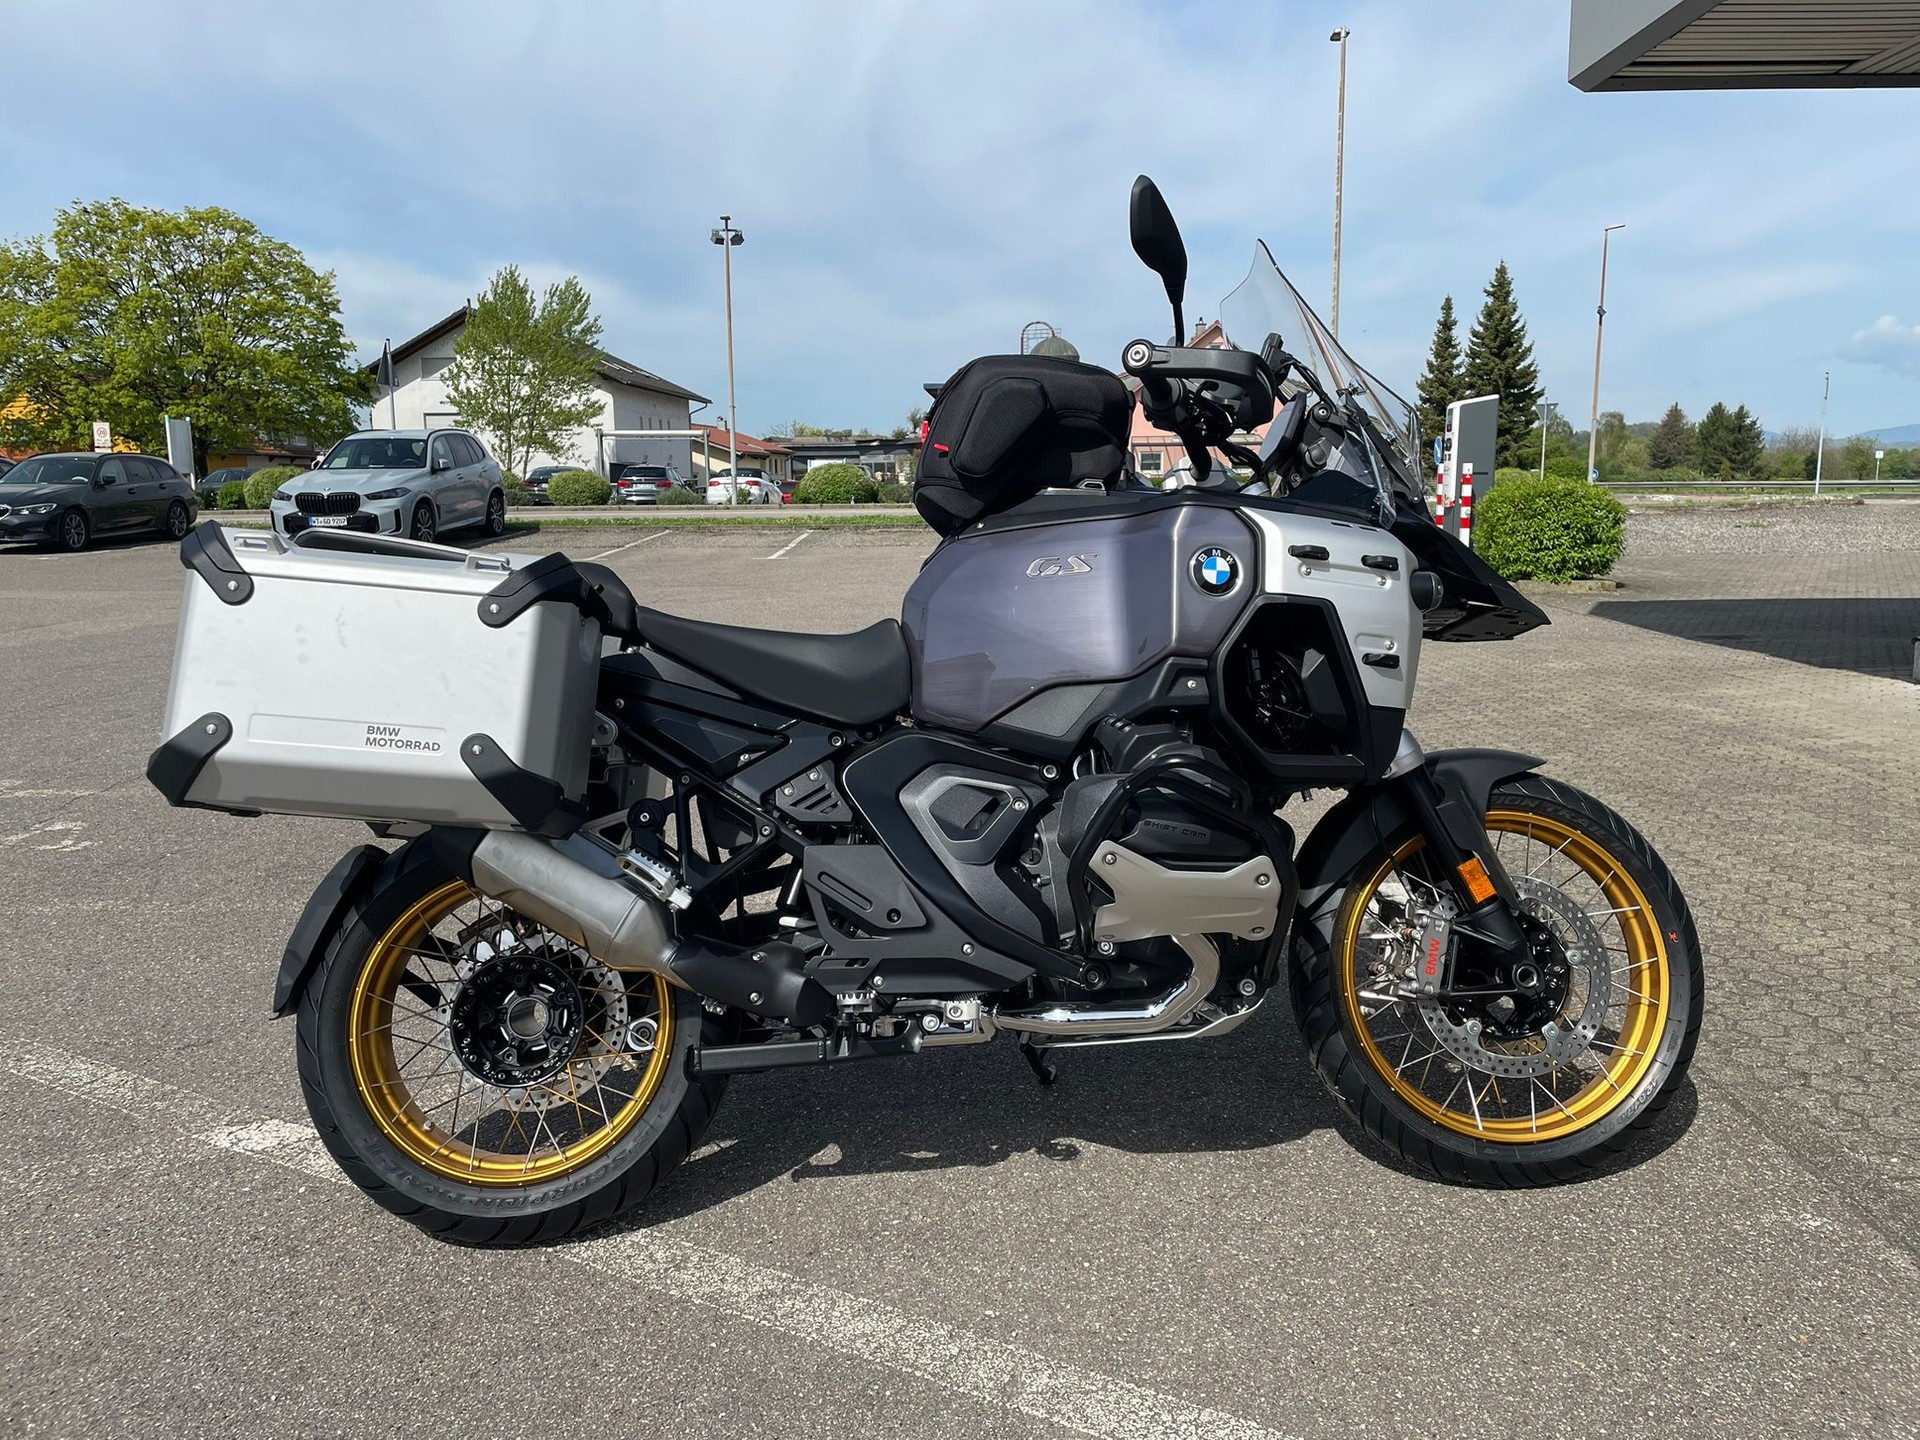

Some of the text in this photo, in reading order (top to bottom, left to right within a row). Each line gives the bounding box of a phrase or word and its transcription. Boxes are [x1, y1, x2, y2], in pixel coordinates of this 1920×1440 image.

[1025, 552, 1098, 578] GS
[367, 725, 401, 737] BMW
[365, 737, 441, 751] MOTORRAD
[1143, 820, 1178, 832] SHIFT
[1425, 937, 1441, 976] BMW
